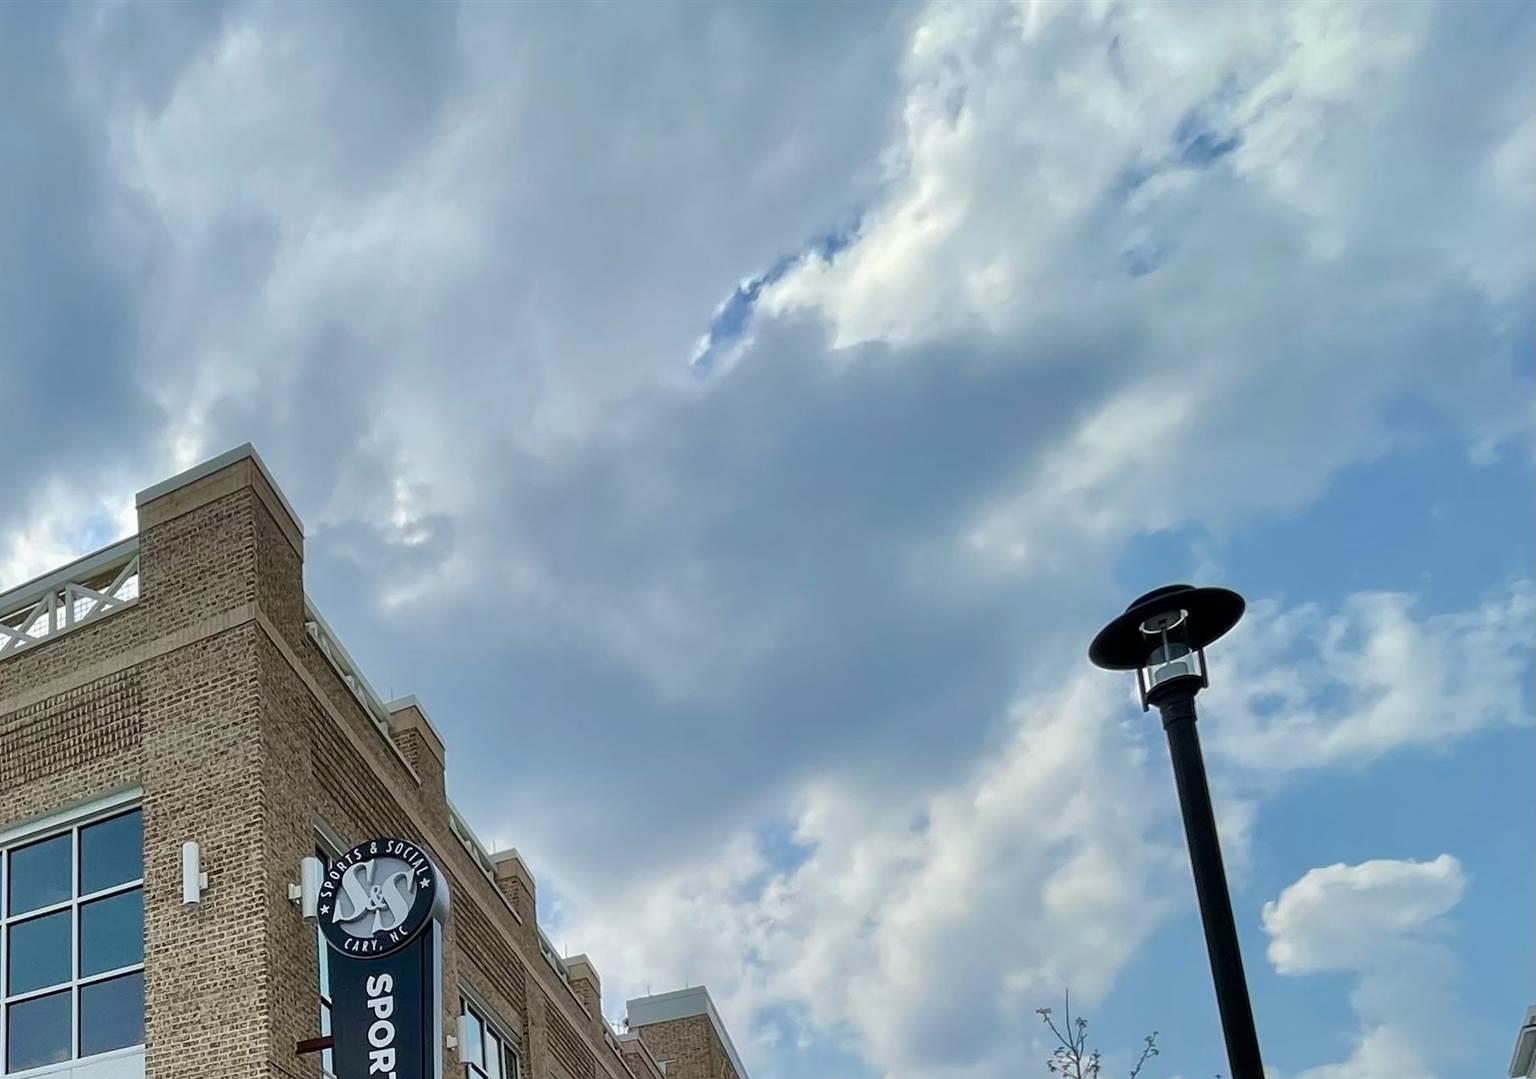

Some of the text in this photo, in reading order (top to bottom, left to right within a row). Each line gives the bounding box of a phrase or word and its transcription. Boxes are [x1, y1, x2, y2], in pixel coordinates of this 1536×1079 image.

[321, 840, 429, 897] SPORTS & SOCIAL
[389, 925, 408, 943] NC
